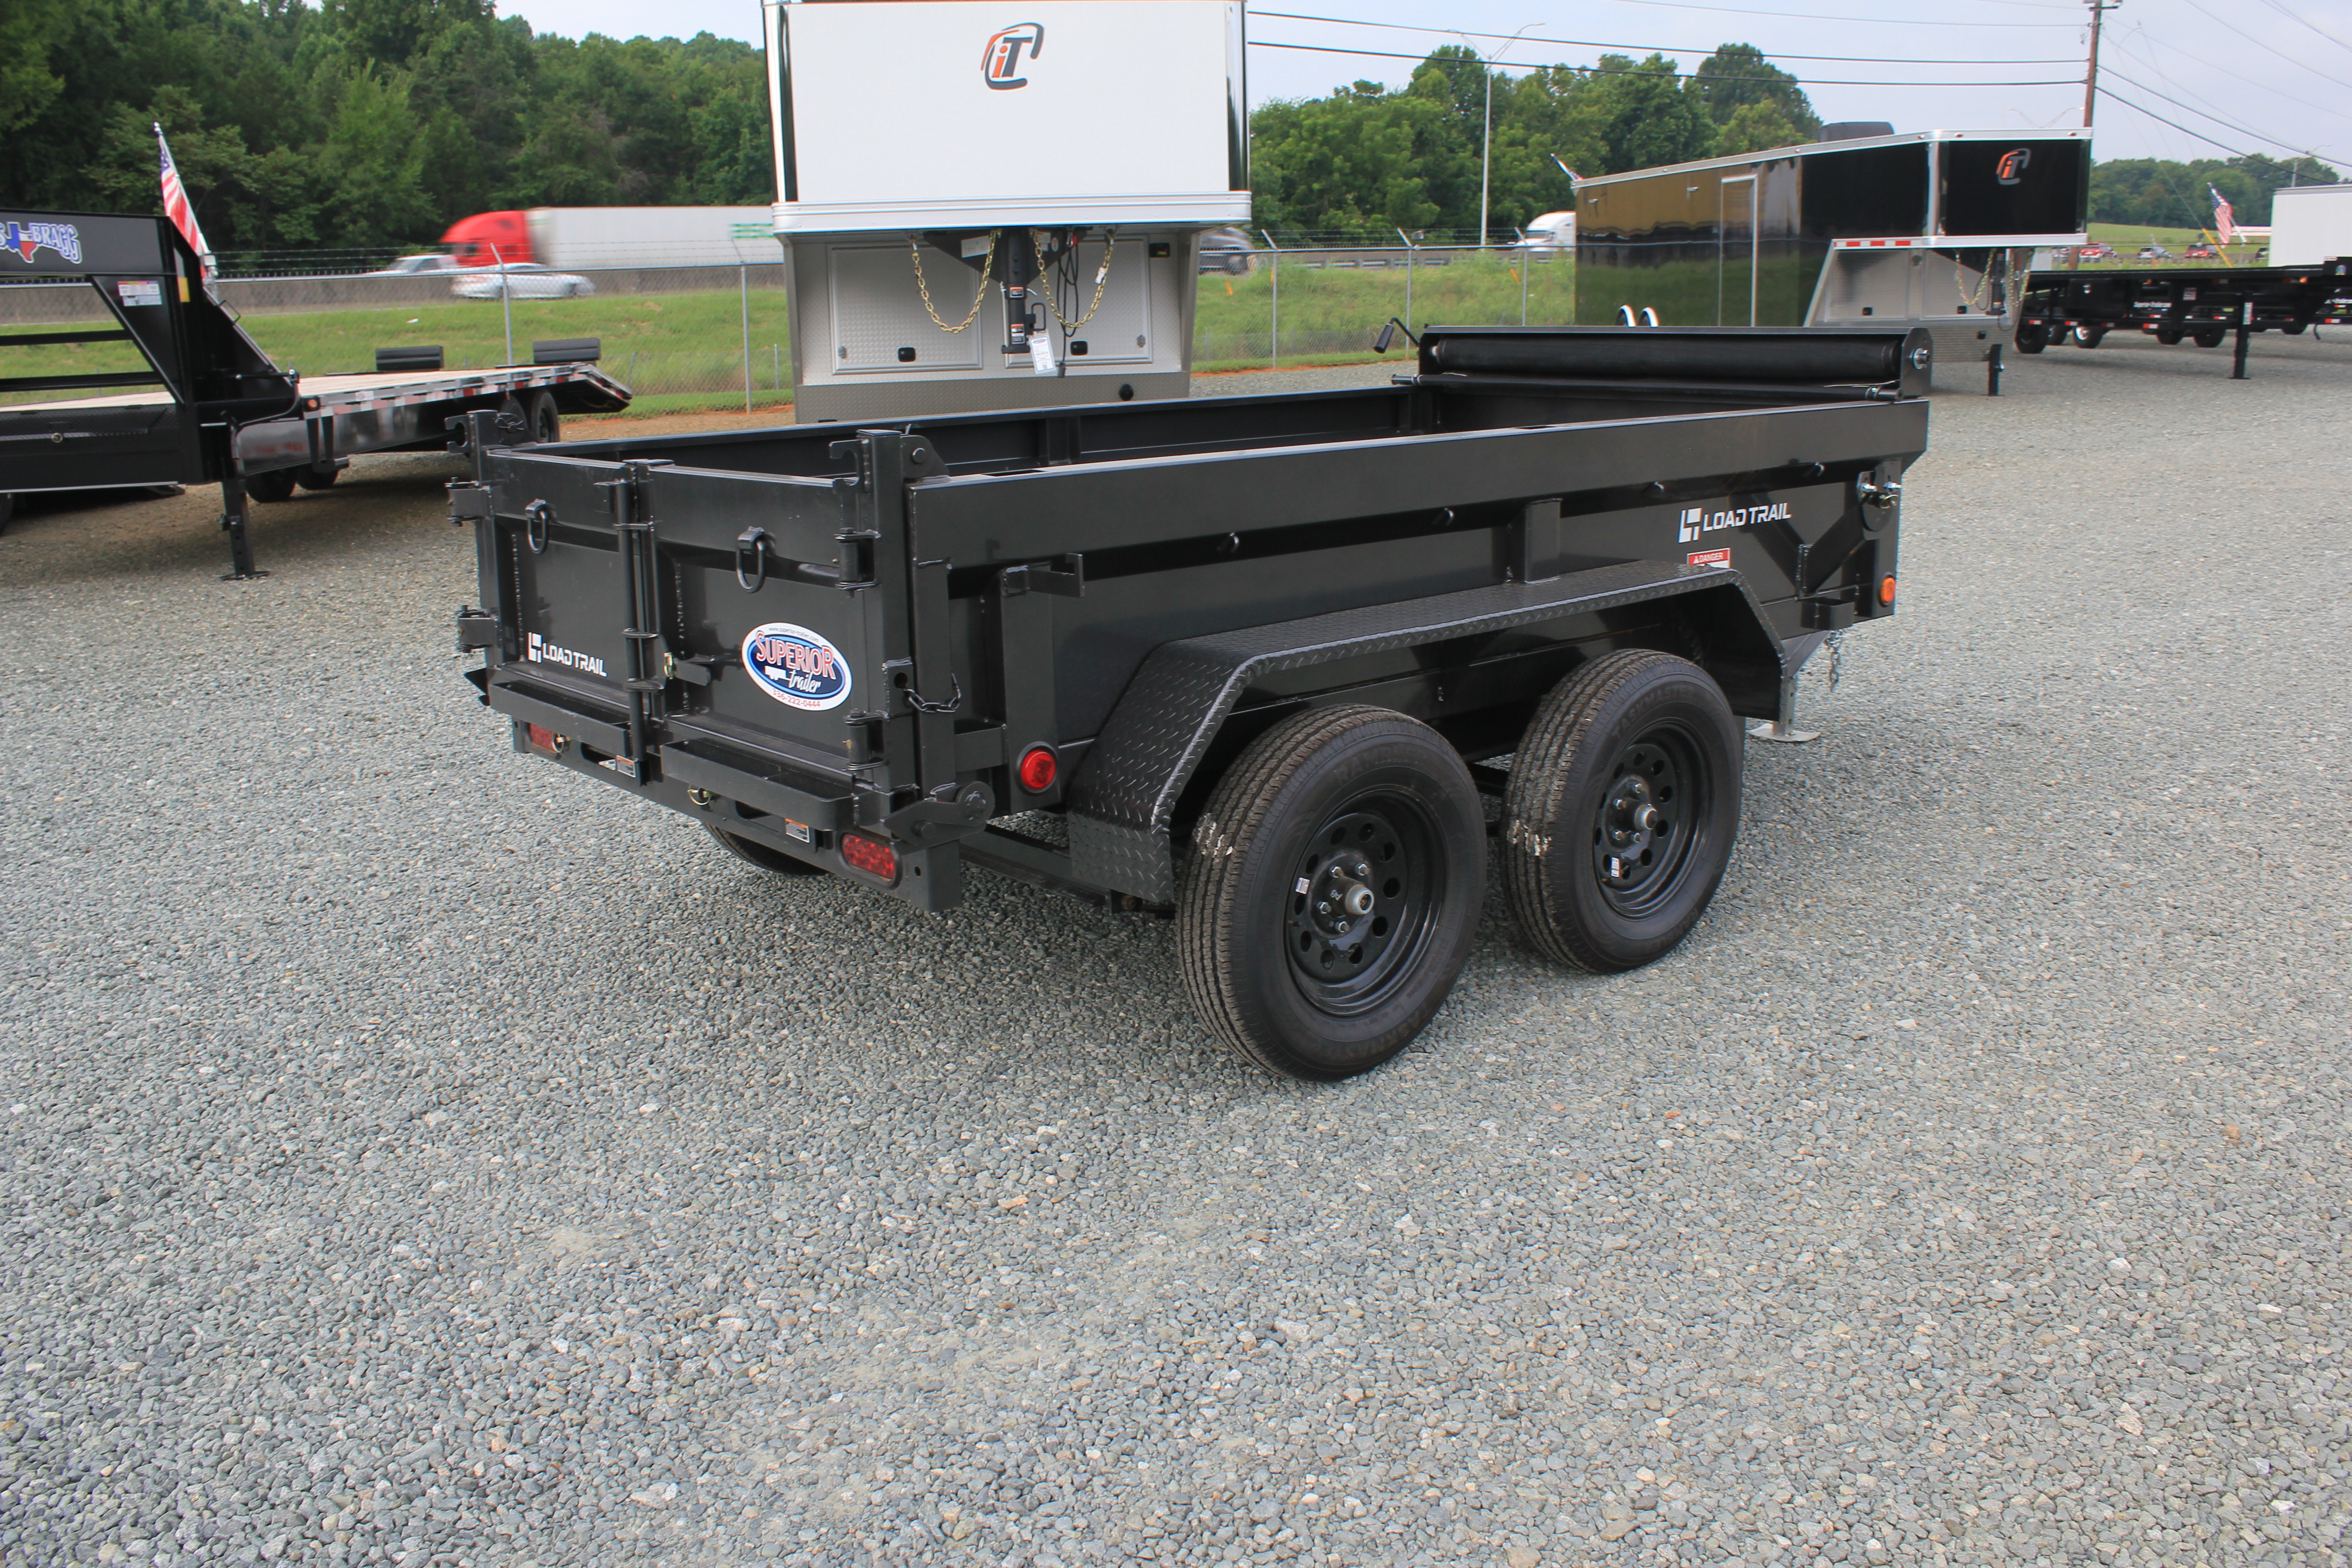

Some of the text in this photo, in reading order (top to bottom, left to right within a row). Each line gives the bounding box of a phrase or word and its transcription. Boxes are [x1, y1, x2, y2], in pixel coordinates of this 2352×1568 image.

[29, 224, 82, 264] BRAGG
[1702, 502, 1792, 531] LOAD TRAIL
[1699, 552, 1723, 563] DANGER
[755, 631, 837, 680] SUPERIOR
[789, 670, 822, 693] trailer
[1612, 684, 1694, 739] TASKMASTER
